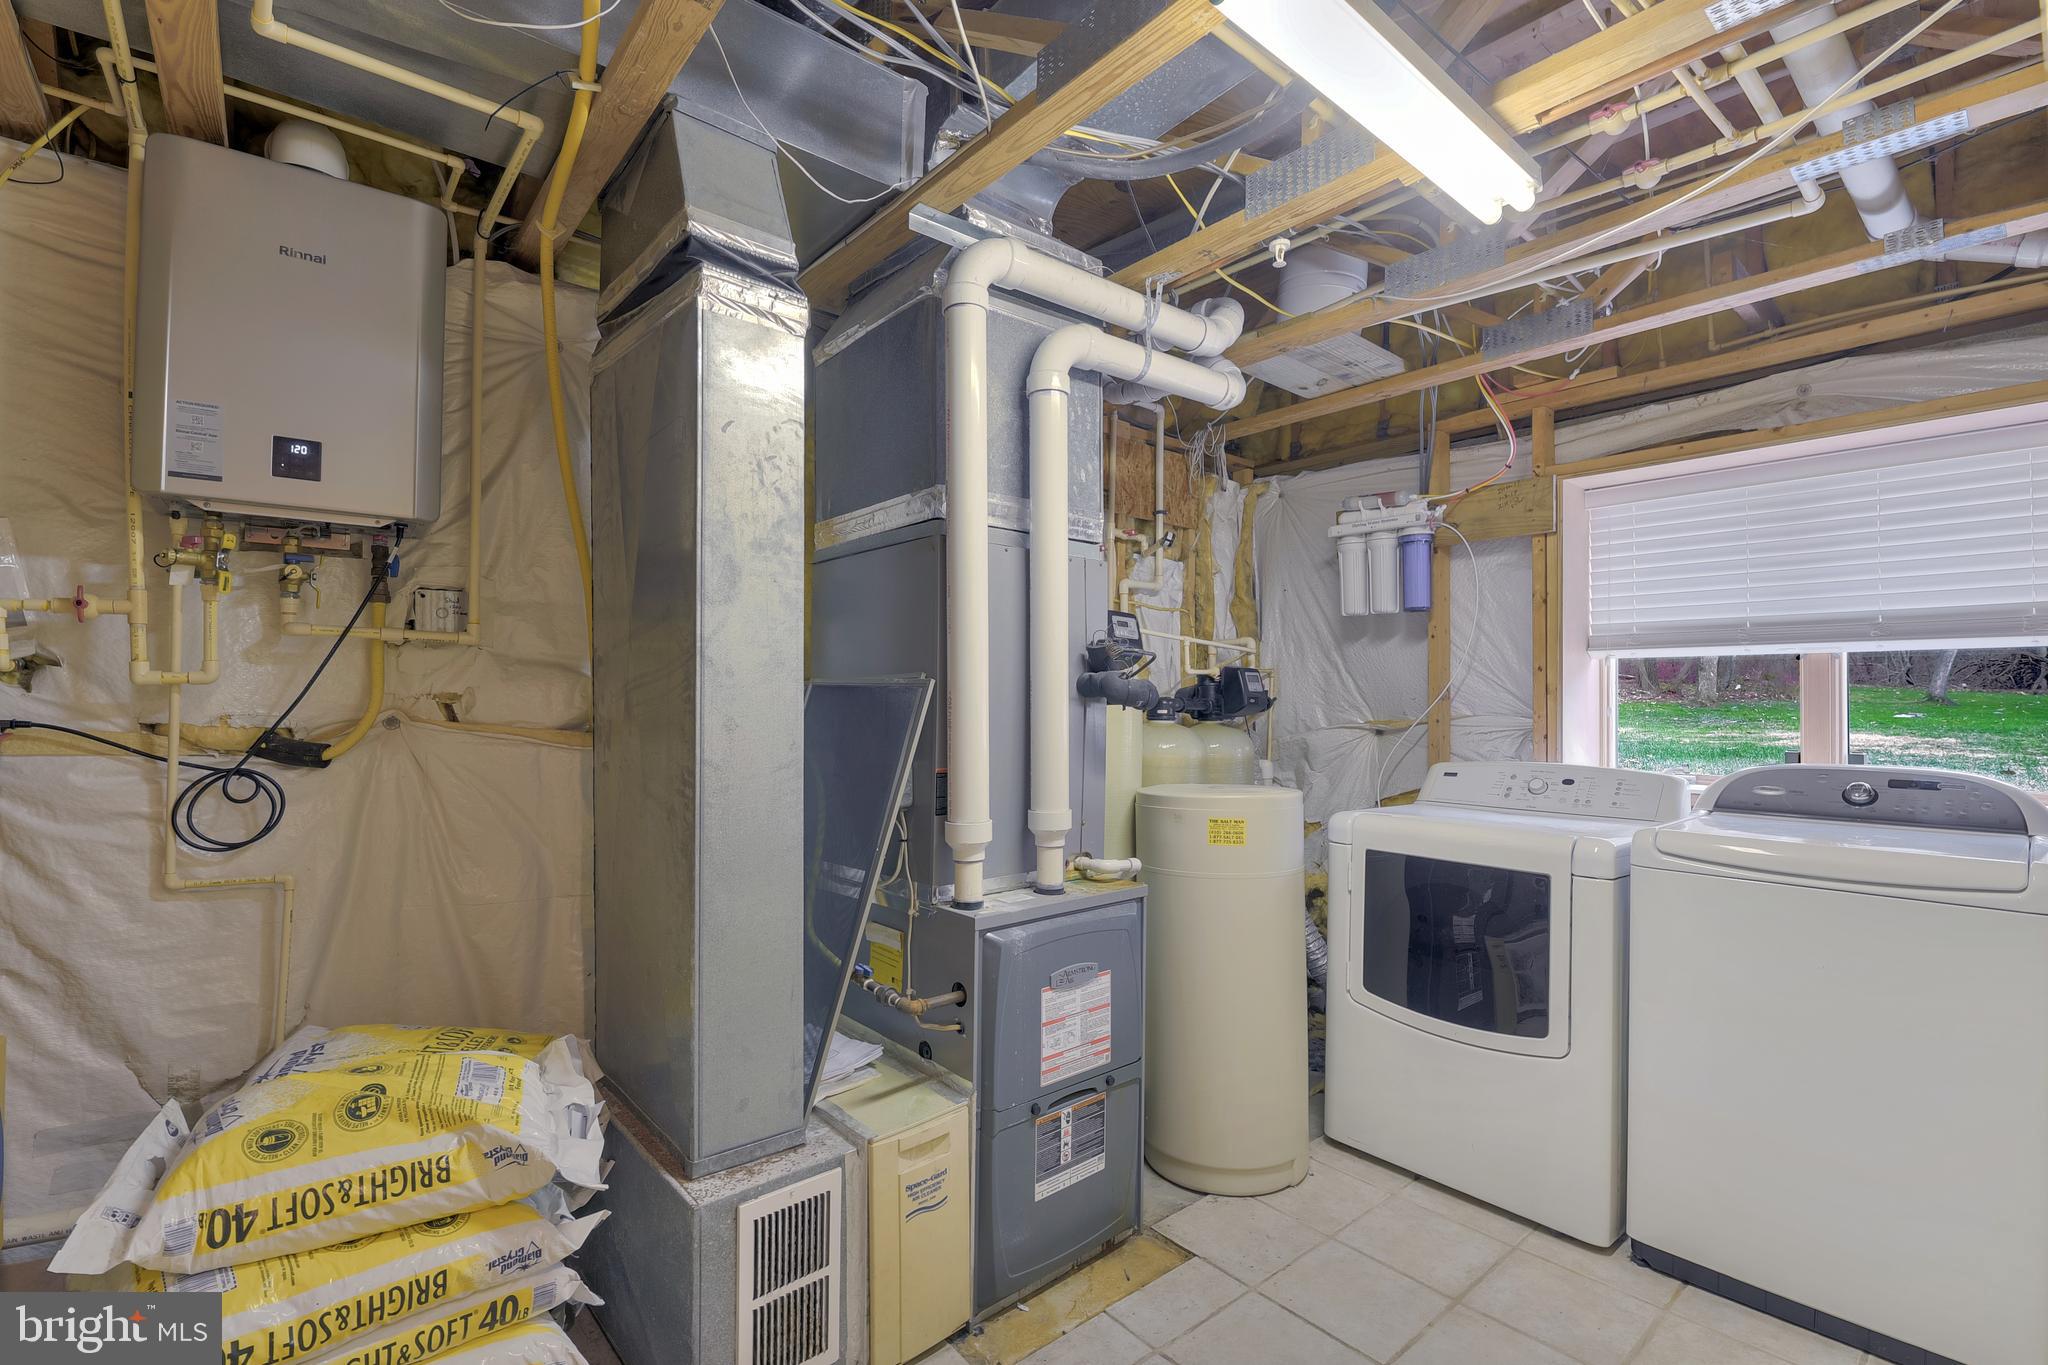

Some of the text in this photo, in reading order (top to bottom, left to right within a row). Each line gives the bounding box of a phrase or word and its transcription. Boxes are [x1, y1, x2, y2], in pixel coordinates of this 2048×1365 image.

[279, 245, 327, 265] Rinnai
[290, 444, 308, 455] 120
[206, 1203, 259, 1249] 40
[500, 1248, 542, 1274] Diamond
[478, 1294, 519, 1331] 40
